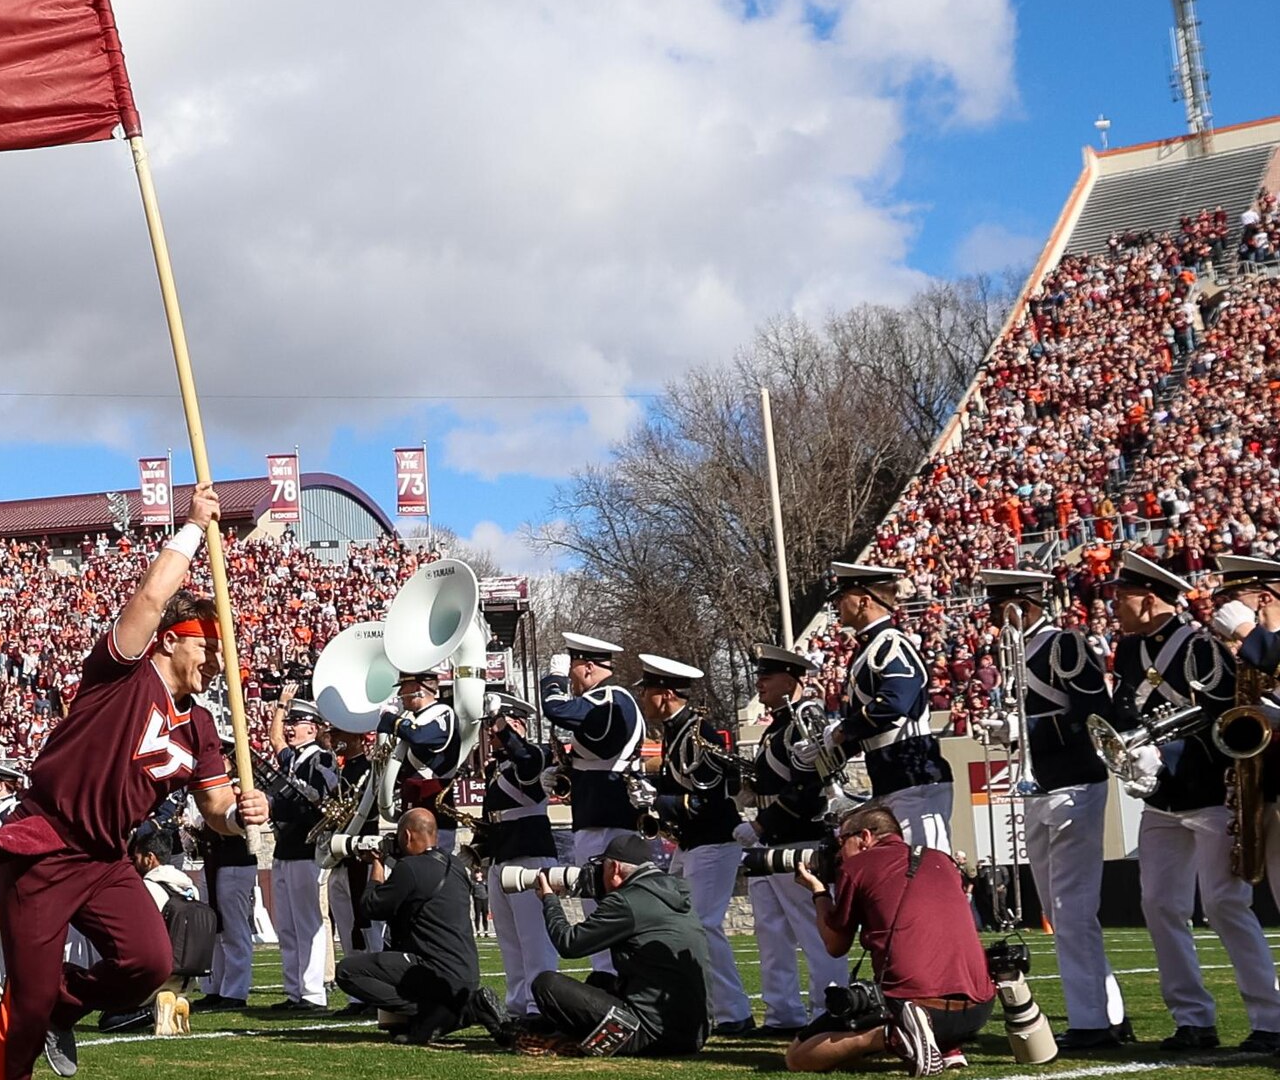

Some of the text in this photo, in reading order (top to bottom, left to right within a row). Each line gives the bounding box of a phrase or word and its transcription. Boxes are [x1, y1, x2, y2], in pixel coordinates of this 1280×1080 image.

[142, 482, 169, 505] 58
[271, 480, 297, 502] 78
[398, 473, 424, 496] 73
[432, 566, 456, 579] YAMAHA
[363, 630, 384, 639] YAMAH
